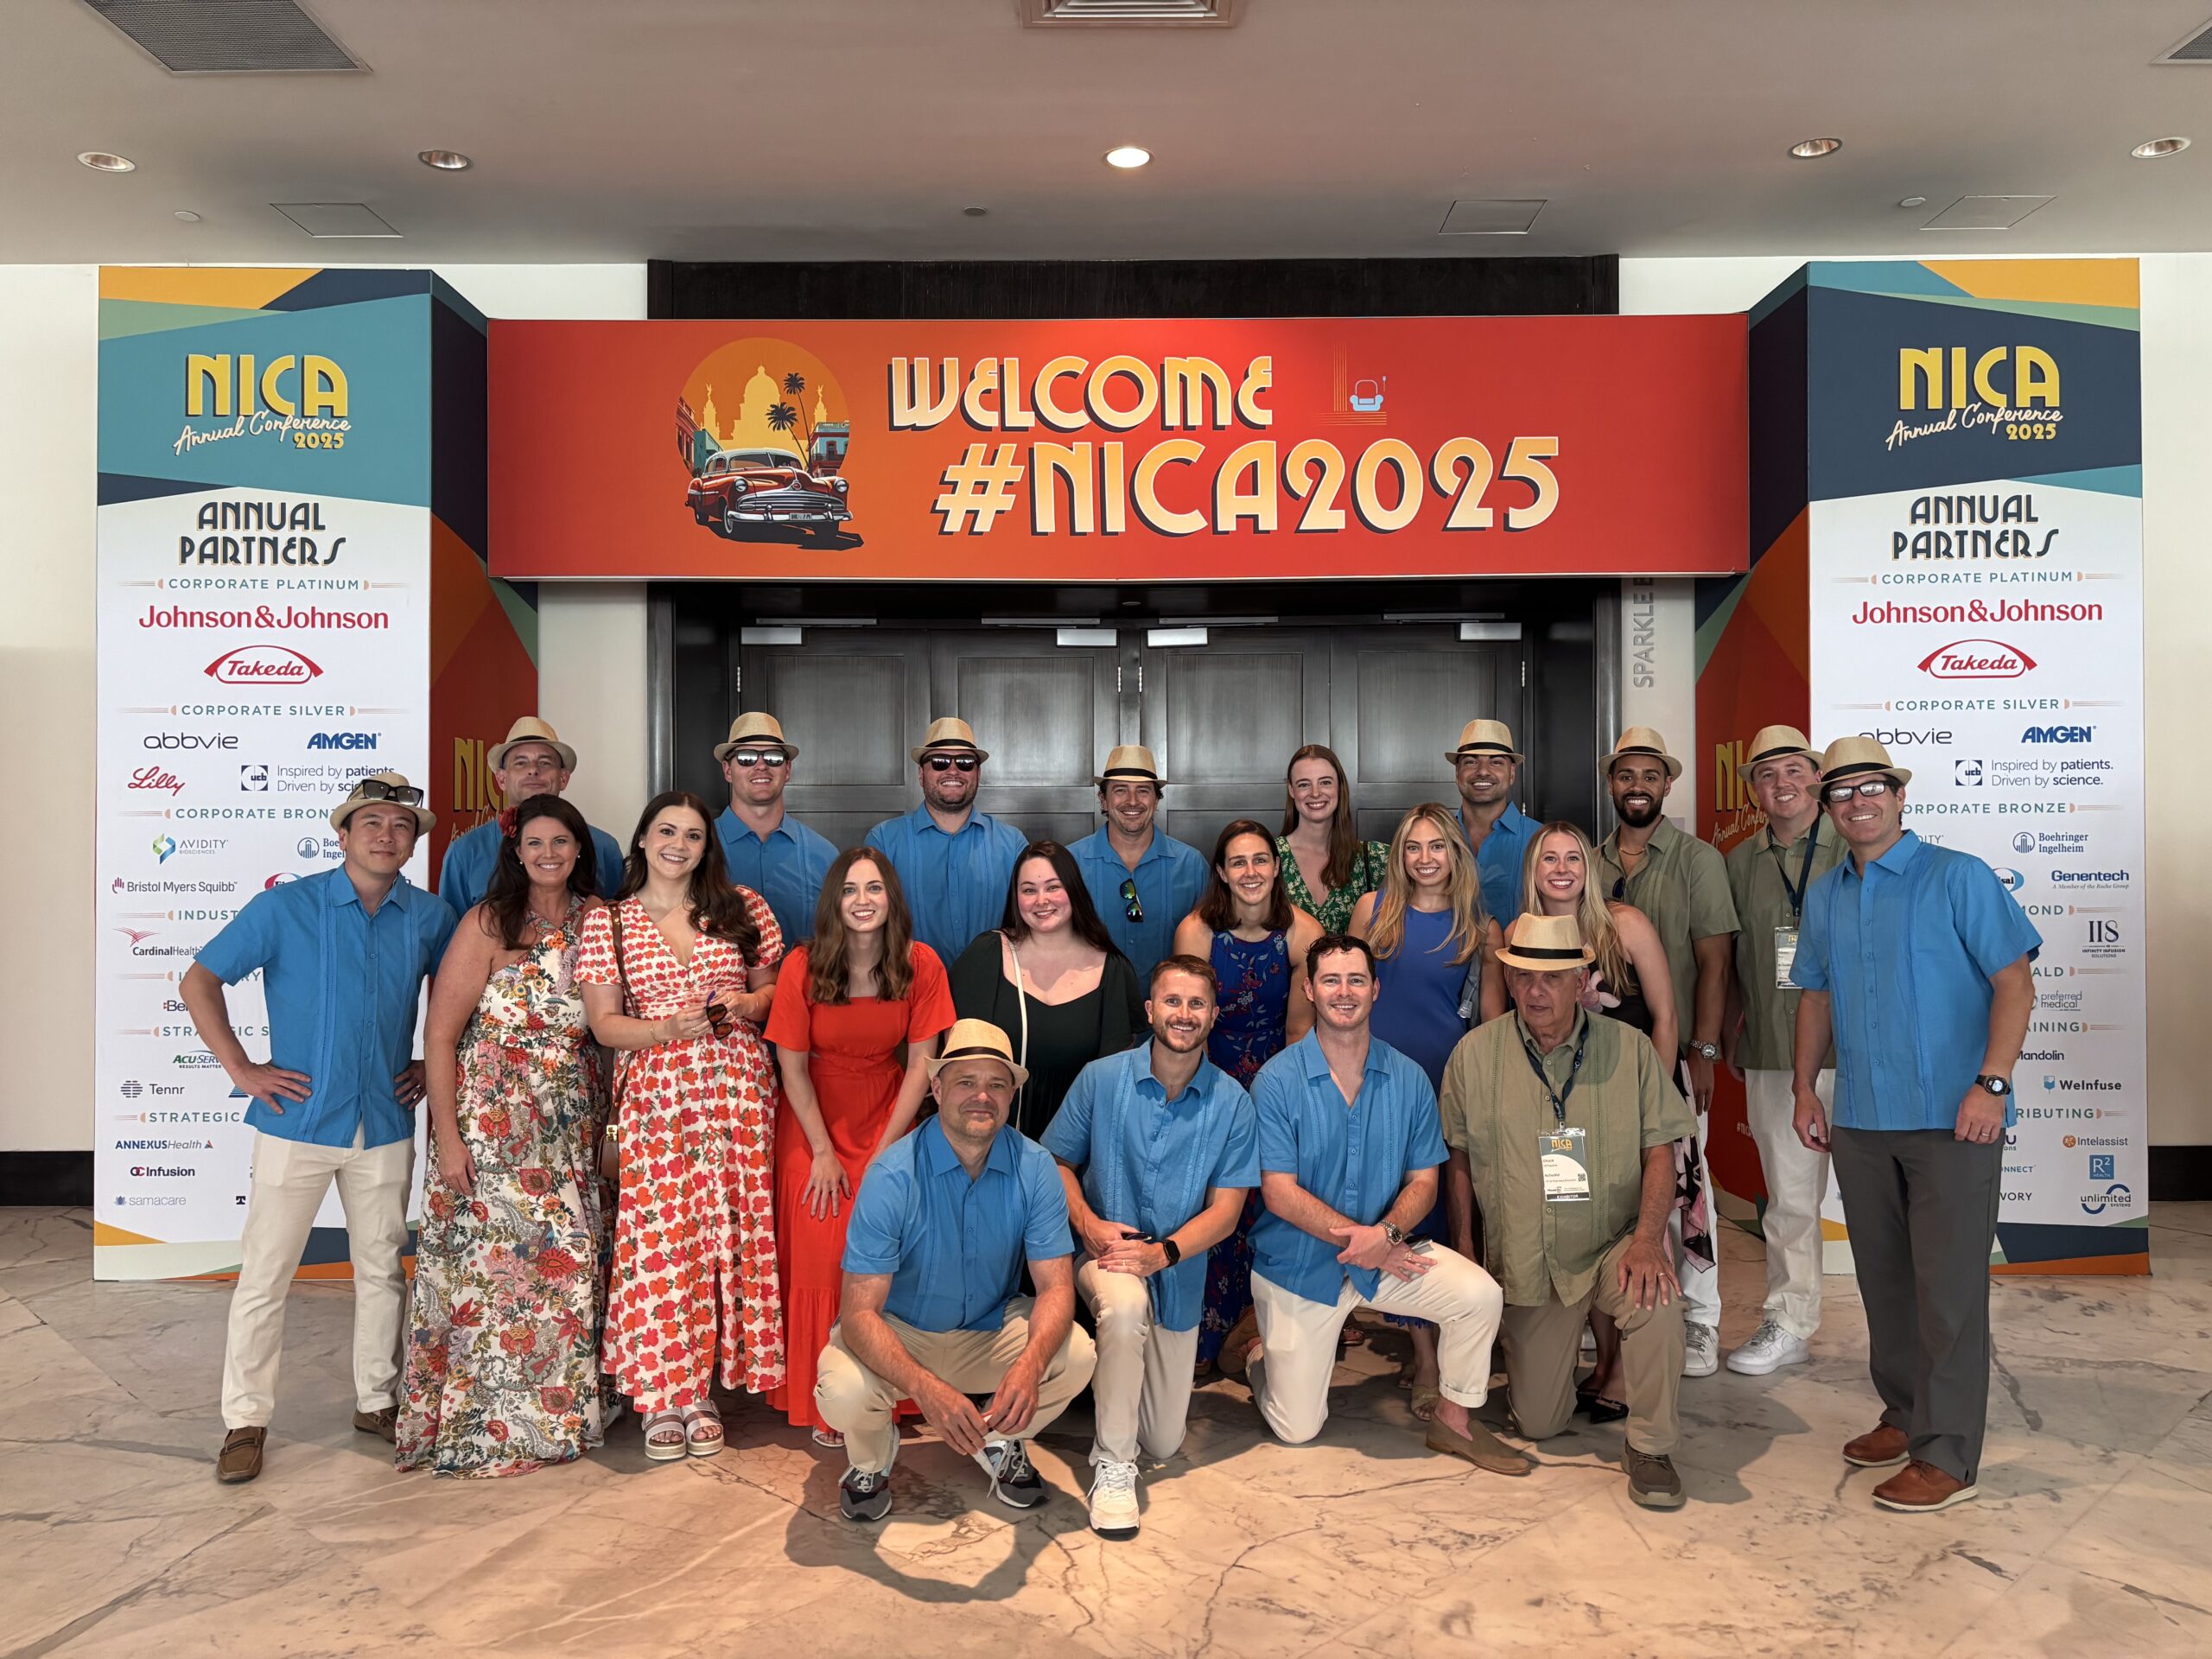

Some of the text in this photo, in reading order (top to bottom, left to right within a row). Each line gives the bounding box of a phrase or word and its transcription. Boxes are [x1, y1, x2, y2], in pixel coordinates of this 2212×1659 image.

[184, 353, 349, 417] NICA
[1897, 346, 2060, 410] NICA
[887, 354, 1273, 432] WELCOME
[173, 410, 352, 456] Annual Conference
[1885, 402, 2063, 451] Annual Conference
[2005, 423, 2056, 441] 2025
[293, 432, 345, 449] 2025
[931, 436, 1560, 537] #NICA2025
[196, 501, 327, 531] ANNUAL
[1909, 493, 2039, 526] ANNUAL
[178, 537, 346, 566] PARTNERS
[1891, 528, 2060, 561] PARTNERS
[168, 578, 359, 591] CORPORATE PLATINUM
[1882, 571, 2073, 585] CORPORATE PLATINUM
[226, 660, 305, 677] Takeda
[1941, 654, 2018, 671] Takeda
[181, 705, 345, 716] CORPORATE SILVER
[1895, 698, 2059, 711] CORPORATE SILVER
[143, 732, 238, 750] abbvie
[307, 732, 378, 750] AMGEN
[2021, 725, 2092, 743] AMGEN
[277, 765, 324, 779] Inspired
[327, 765, 342, 779] by
[1965, 766, 1981, 776] ucb
[1991, 759, 2113, 774] Inspired by patients.
[127, 766, 186, 797] Lilly
[251, 772, 267, 781] ucb
[1992, 774, 2104, 788] Driven by science.
[277, 780, 316, 791] Driven
[320, 780, 334, 794] by
[175, 808, 335, 819] CORPORATE BRON
[1902, 803, 2066, 814] ORPORATE BRONZE
[179, 839, 226, 849] AVIDITY
[2038, 832, 2088, 843] Boehringer
[2038, 843, 2084, 854] Ingelheim
[2051, 869, 2130, 881] Genentech
[127, 881, 161, 892] Bristol
[163, 881, 196, 894] Myers
[2088, 920, 2120, 943] IIS
[2041, 989, 2082, 1001] preferred
[2041, 999, 2078, 1008] medical
[149, 1084, 185, 1095] Tennr
[2059, 1079, 2122, 1090] WeInfuse
[149, 1112, 241, 1122] STRATEGIC
[1551, 1139, 1573, 1149] NICA
[2077, 1136, 2128, 1147] Intelassist
[129, 1196, 187, 1206] samacare
[2080, 1193, 2132, 1203] unlimited
